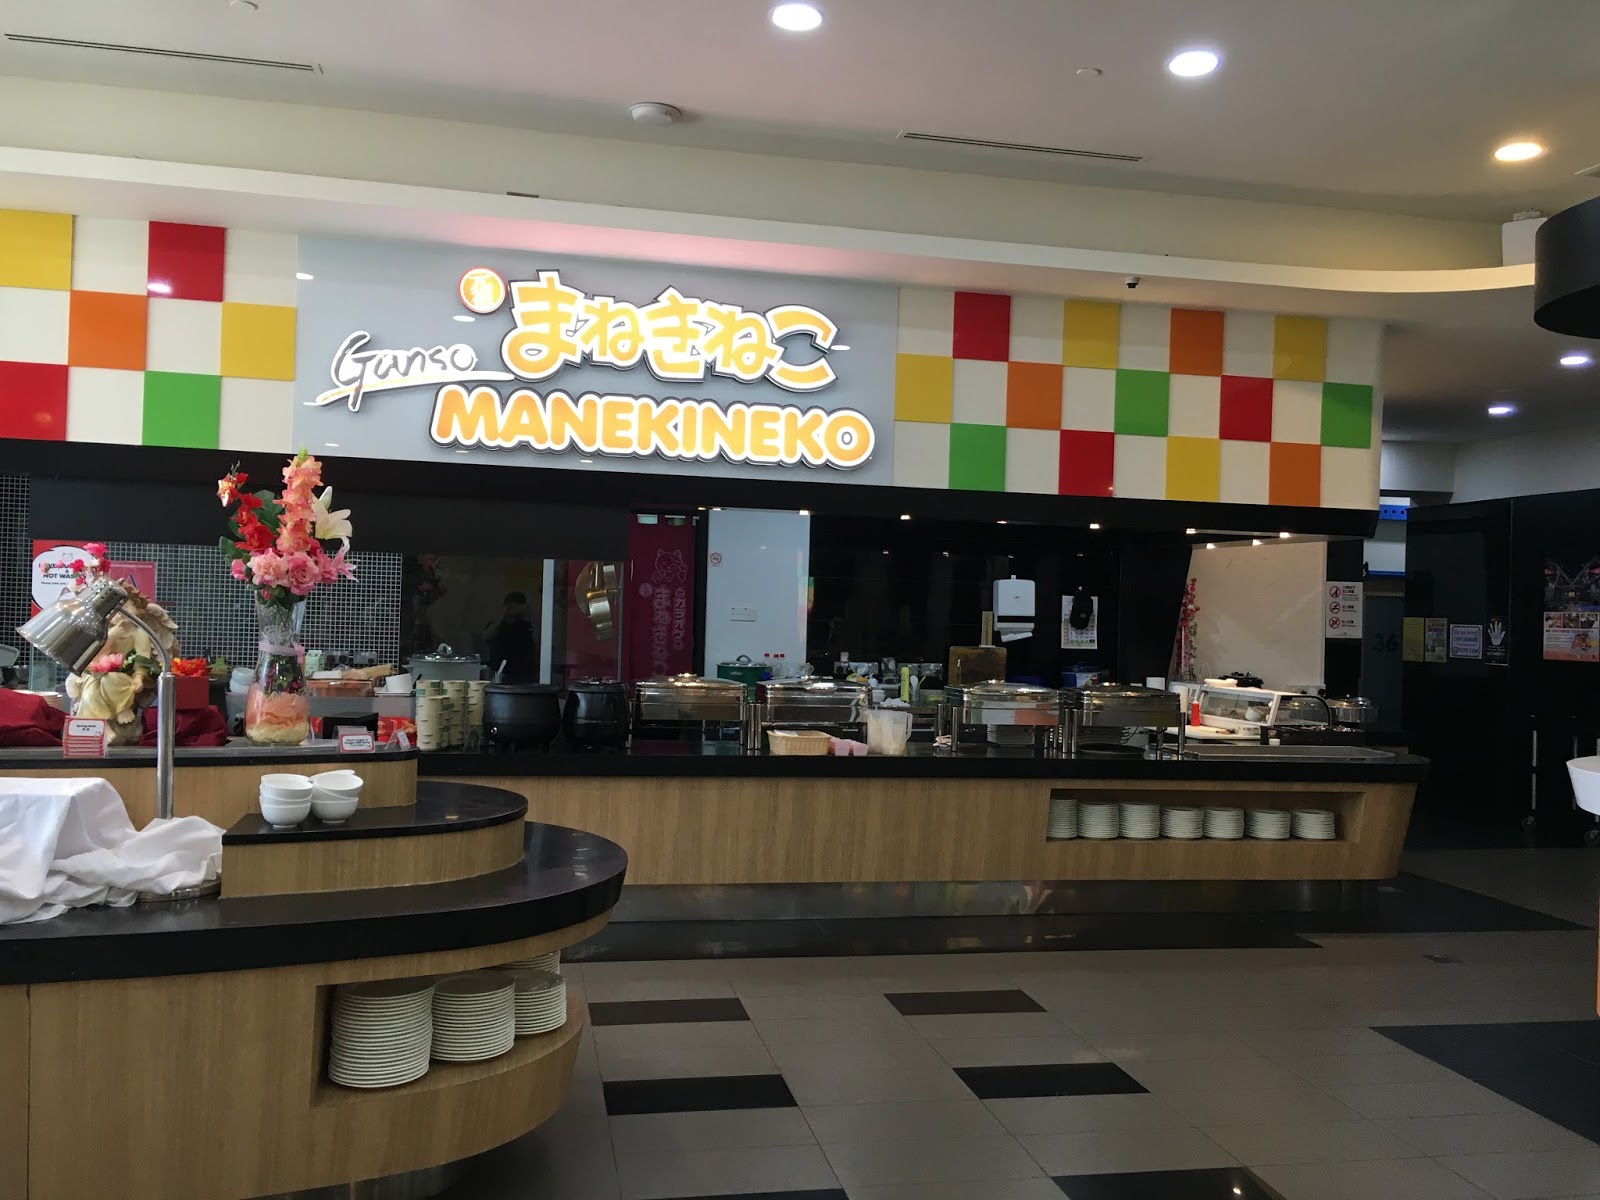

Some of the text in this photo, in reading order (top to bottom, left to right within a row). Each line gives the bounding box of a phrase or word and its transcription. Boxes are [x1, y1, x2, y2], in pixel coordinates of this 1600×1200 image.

[331, 331, 478, 411] Ganso
[501, 270, 838, 391] まねきねこ
[432, 384, 875, 469] MANEKINEKO
